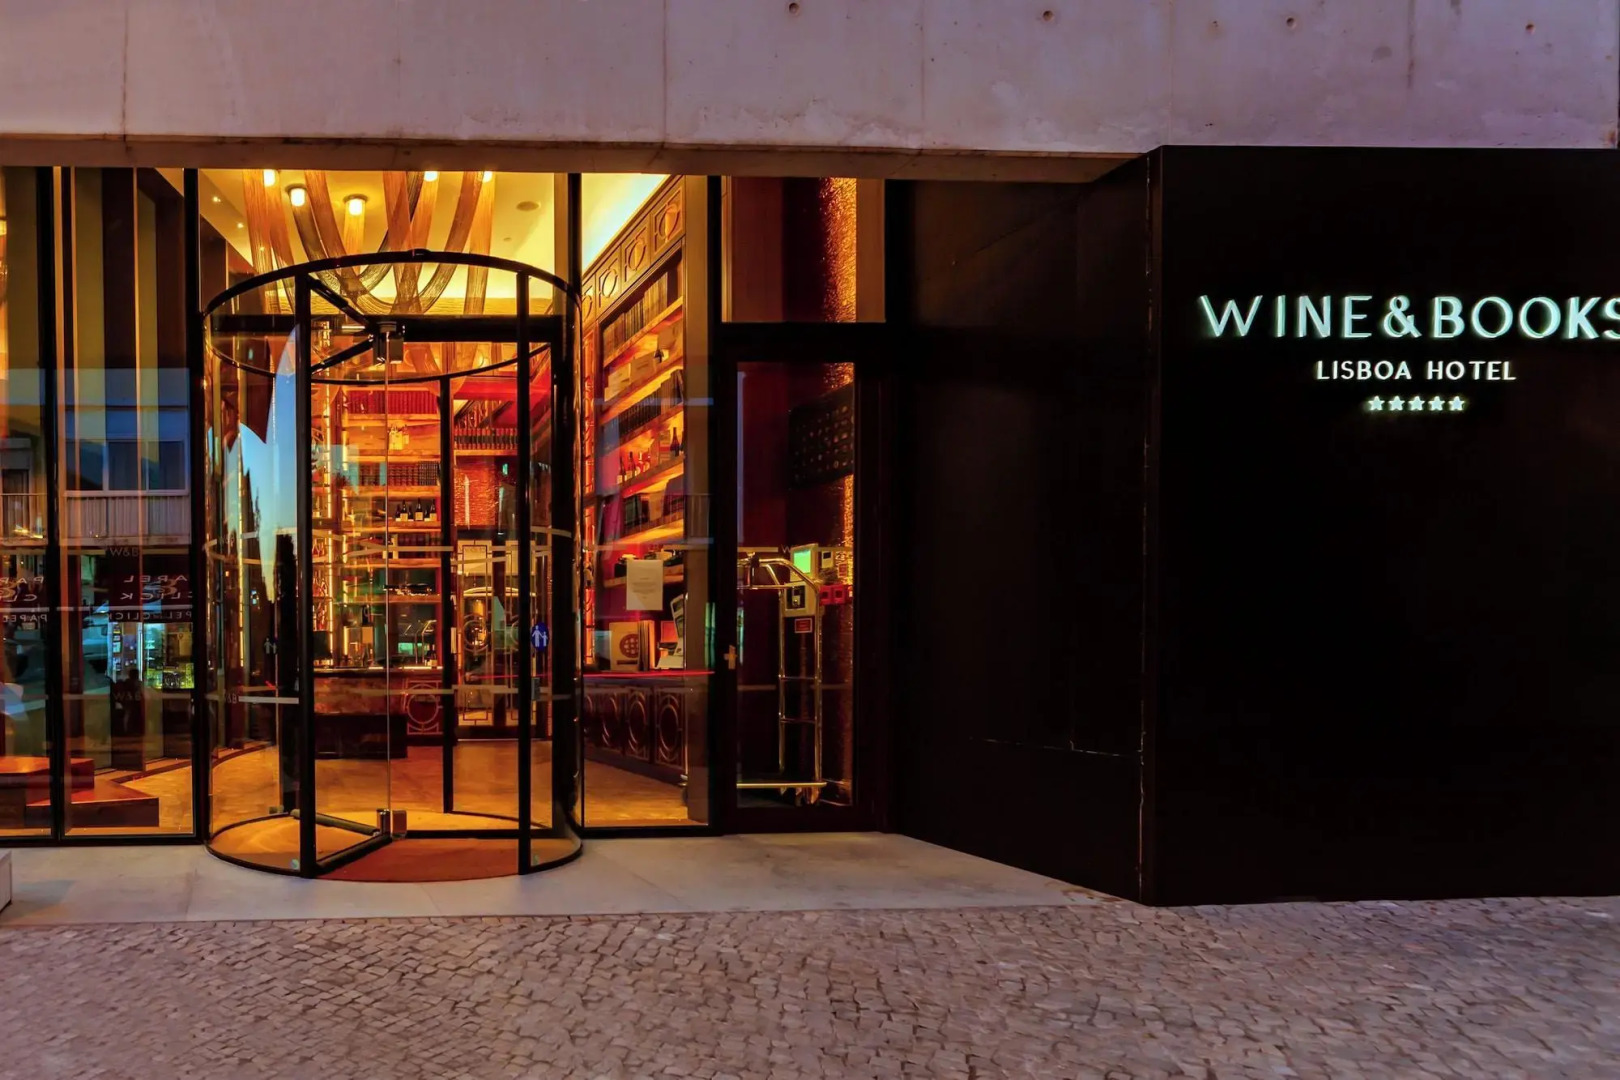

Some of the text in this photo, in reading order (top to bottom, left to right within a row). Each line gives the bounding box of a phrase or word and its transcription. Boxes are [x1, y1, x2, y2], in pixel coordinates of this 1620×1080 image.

[1199, 294, 1620, 339] WINE&BOOKS
[1316, 360, 1517, 380] LISBOA HOTEL
